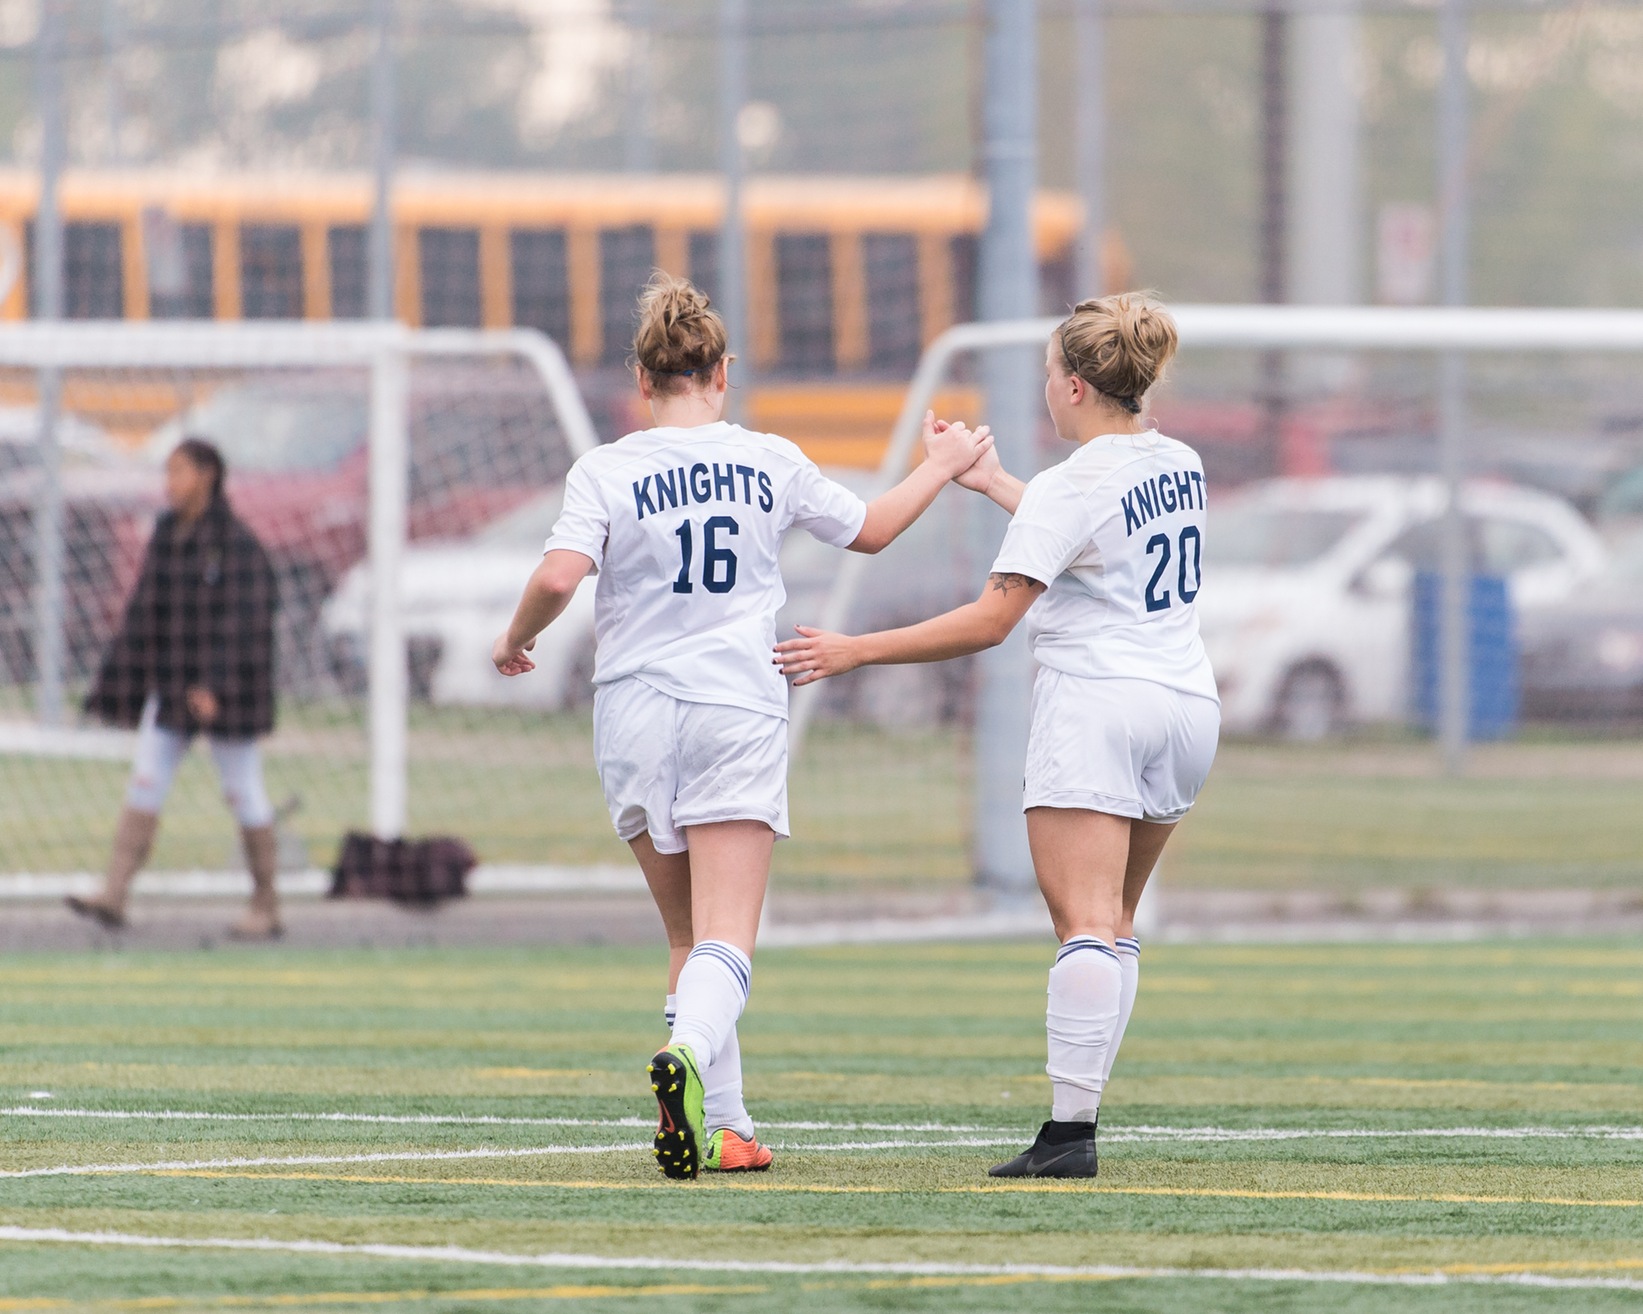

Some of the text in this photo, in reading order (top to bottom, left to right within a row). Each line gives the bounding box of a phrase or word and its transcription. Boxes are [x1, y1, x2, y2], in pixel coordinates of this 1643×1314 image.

[632, 462, 774, 521] KNIGHTS
[672, 515, 739, 594] 16
[1144, 525, 1201, 613] 20
